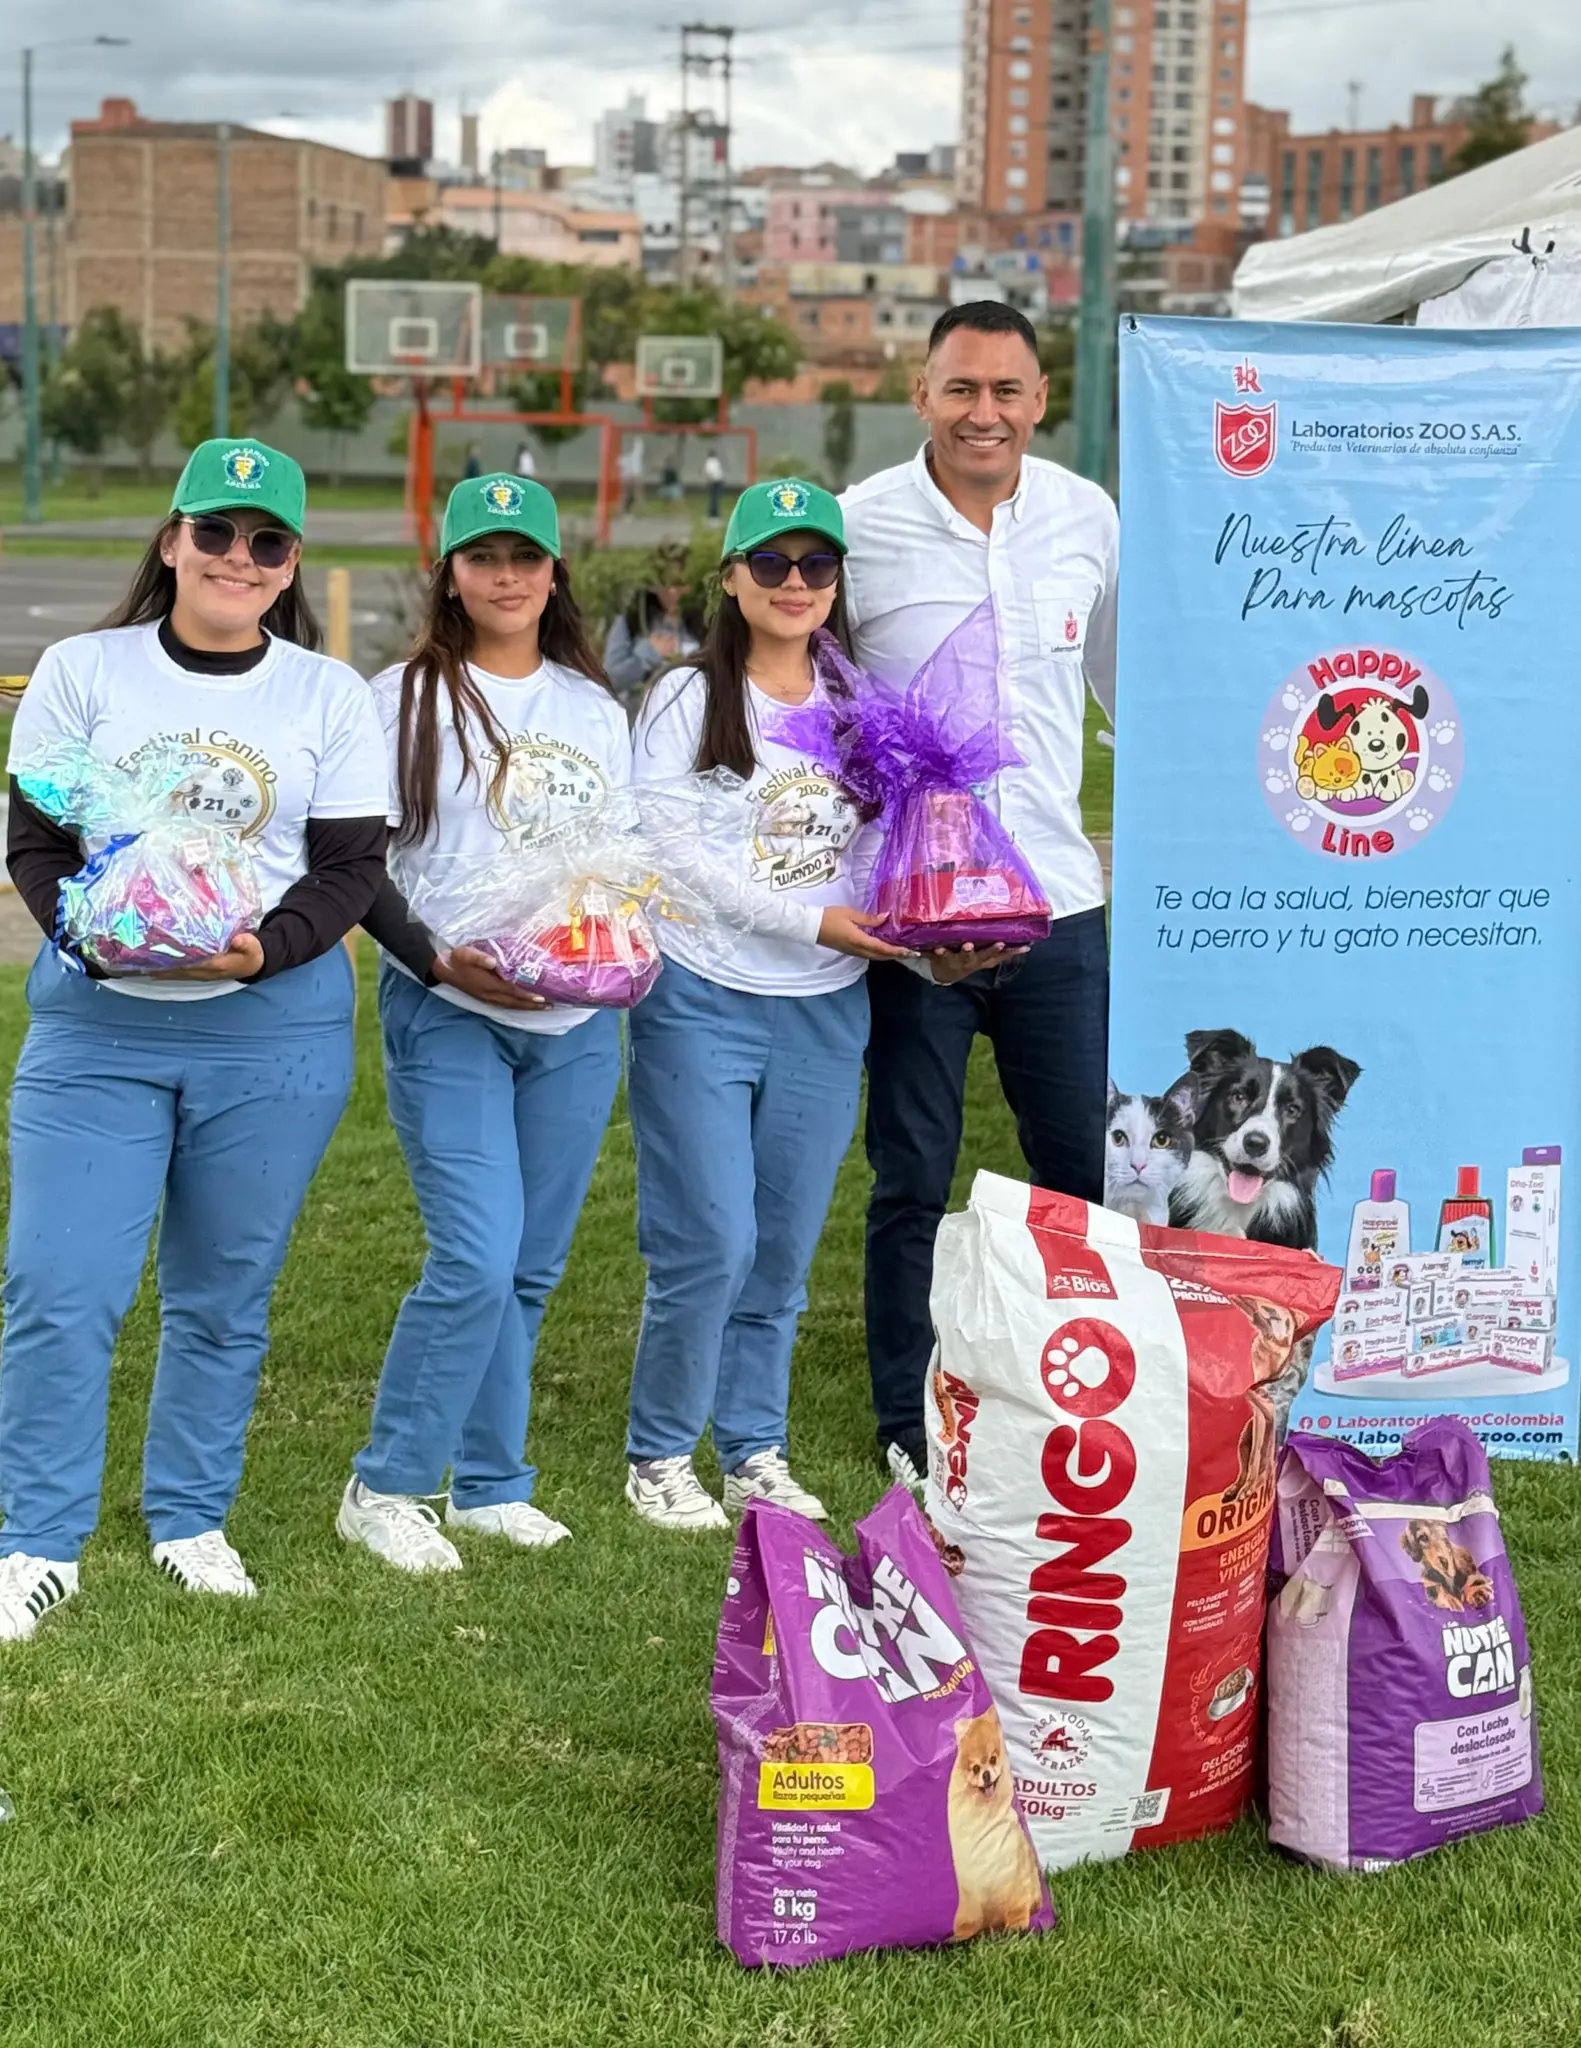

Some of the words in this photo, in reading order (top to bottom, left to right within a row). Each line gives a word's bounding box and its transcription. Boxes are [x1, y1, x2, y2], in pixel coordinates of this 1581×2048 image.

[1291, 420, 1414, 440] Laboratorios
[1418, 422, 1466, 440] ZOO
[1470, 424, 1522, 441] S.A.S.
[1346, 441, 1407, 454] Veterinarios
[1410, 443, 1421, 454] de
[1424, 443, 1466, 455] absoluta
[1214, 512, 1368, 575] Nuestra
[1242, 567, 1335, 621] Para
[1344, 569, 1515, 630] mascotas
[1307, 649, 1423, 689] Happy
[179, 752, 224, 768] 2026
[209, 730, 278, 784] Canino
[524, 748, 556, 760] 2026
[535, 732, 600, 770] Canino
[796, 784, 829, 798] 2026
[1320, 823, 1395, 858] Line
[775, 859, 822, 886] WANDO
[1155, 885, 1182, 910] Te
[1192, 885, 1231, 910] da
[1239, 885, 1266, 910] la
[1274, 885, 1353, 912] salud,
[1364, 884, 1491, 909] bienestar
[1498, 888, 1550, 913] que
[1157, 924, 1183, 948] tu
[1190, 928, 1269, 954] perro
[1276, 928, 1293, 954] y
[1300, 923, 1326, 948] tu
[1334, 923, 1399, 954] gato
[1406, 921, 1542, 947] necesitan.
[1019, 1317, 1137, 1703] RINGO
[923, 1659, 976, 1702] PREMIUM
[1447, 1642, 1515, 1698] CAN
[1029, 1713, 1057, 1739] PARA
[1060, 1711, 1093, 1742] TODAS
[1457, 1725, 1479, 1738] Con
[1481, 1715, 1510, 1731] Leche
[1450, 1727, 1517, 1756] deslactosada
[1030, 1746, 1047, 1767] LAS
[1050, 1751, 1089, 1771] RAZAS
[1207, 1754, 1243, 1782] SABOR
[773, 1770, 845, 1790] Adultos
[773, 1791, 798, 1800] Razas
[800, 1791, 846, 1803] pequeñas
[771, 1822, 808, 1832] Vitalidad
[809, 1825, 814, 1834] y
[816, 1822, 841, 1832] salud
[772, 1836, 791, 1845] para
[792, 1835, 801, 1844] tu
[772, 1858, 783, 1867] for
[785, 1859, 802, 1869] your
[799, 1846, 816, 1856] and
[817, 1846, 845, 1856] health
[773, 1887, 795, 1897] Peso
[796, 1888, 818, 1898] neto
[773, 1898, 786, 1916] 8
[791, 1897, 816, 1921] kg
[773, 1930, 801, 1944] 17.6
[803, 1929, 818, 1944] lb
